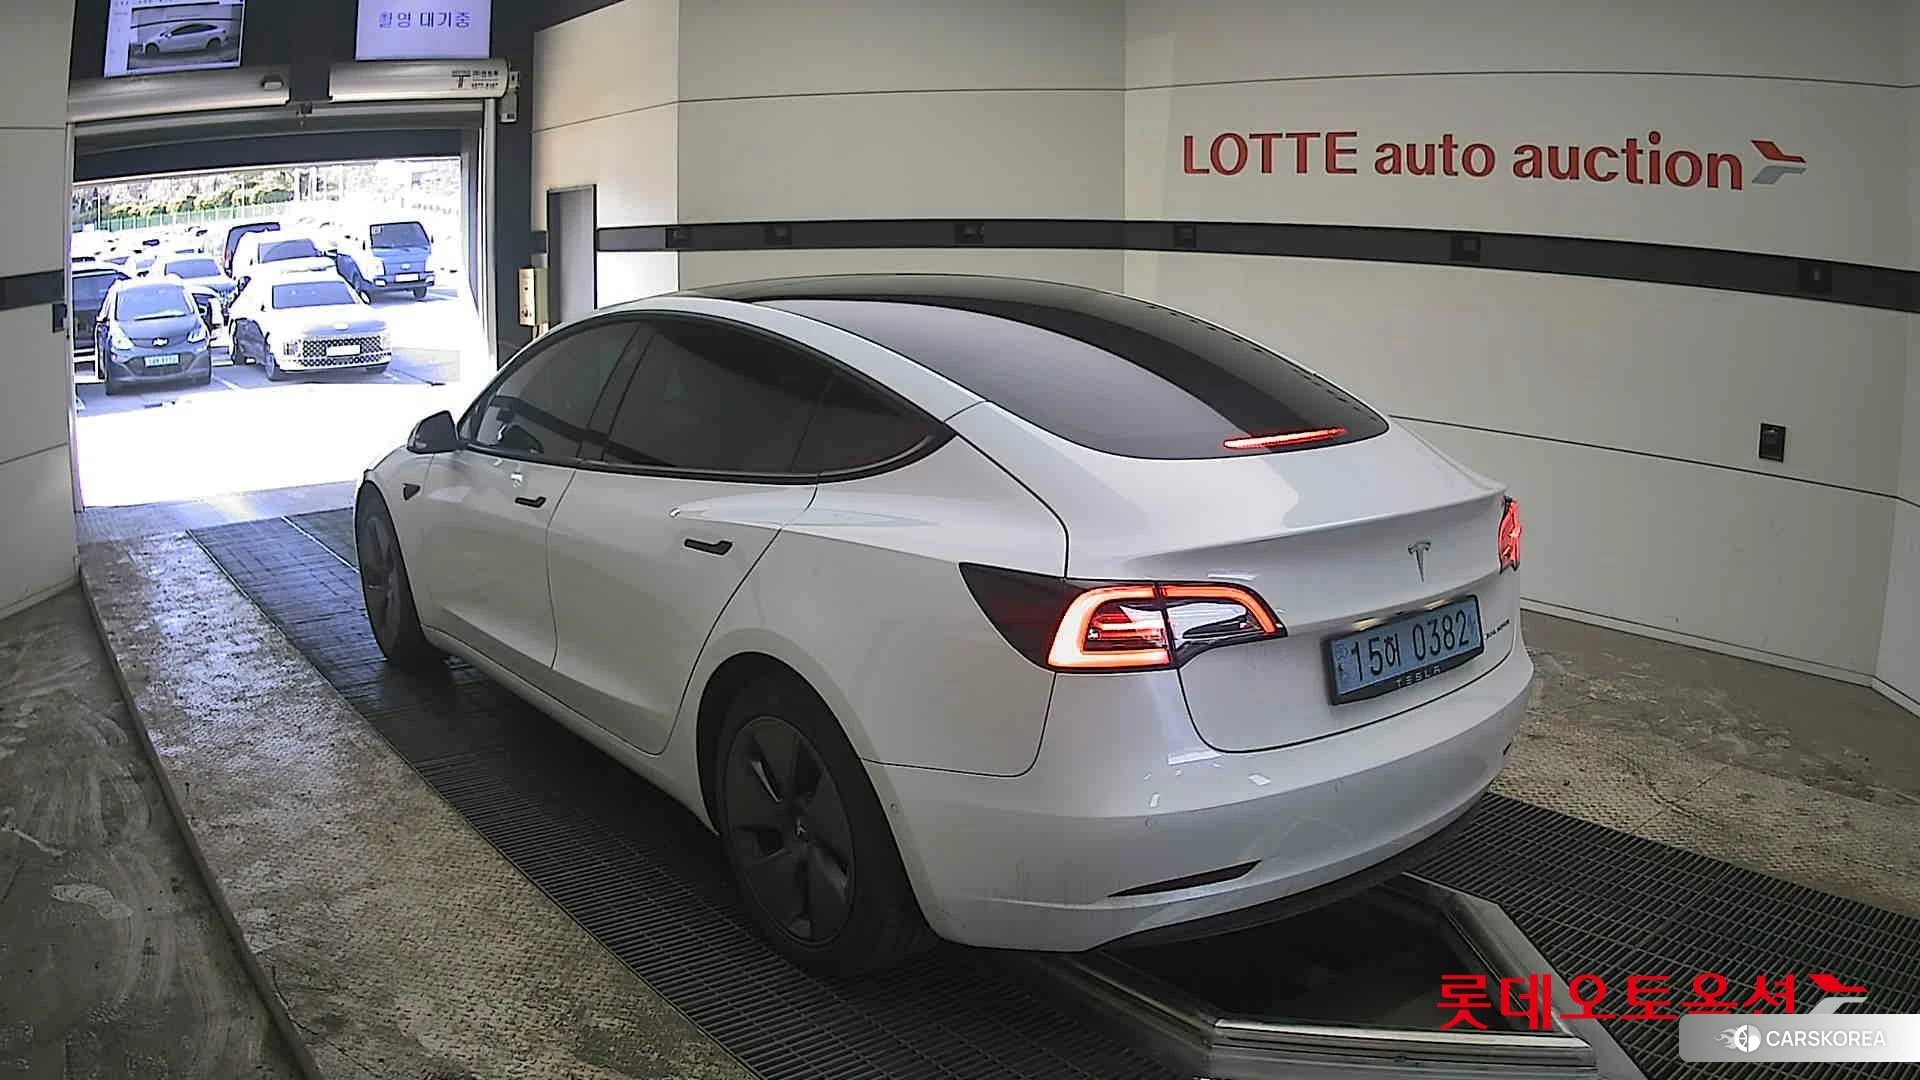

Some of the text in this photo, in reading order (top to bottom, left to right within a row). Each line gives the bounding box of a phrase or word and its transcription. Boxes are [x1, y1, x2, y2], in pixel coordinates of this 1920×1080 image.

[420, 11, 472, 28] 대기중
[1184, 131, 1742, 190] LOTTE auto auction
[1412, 610, 1469, 661] 0382
[1395, 664, 1441, 687] TESLA
